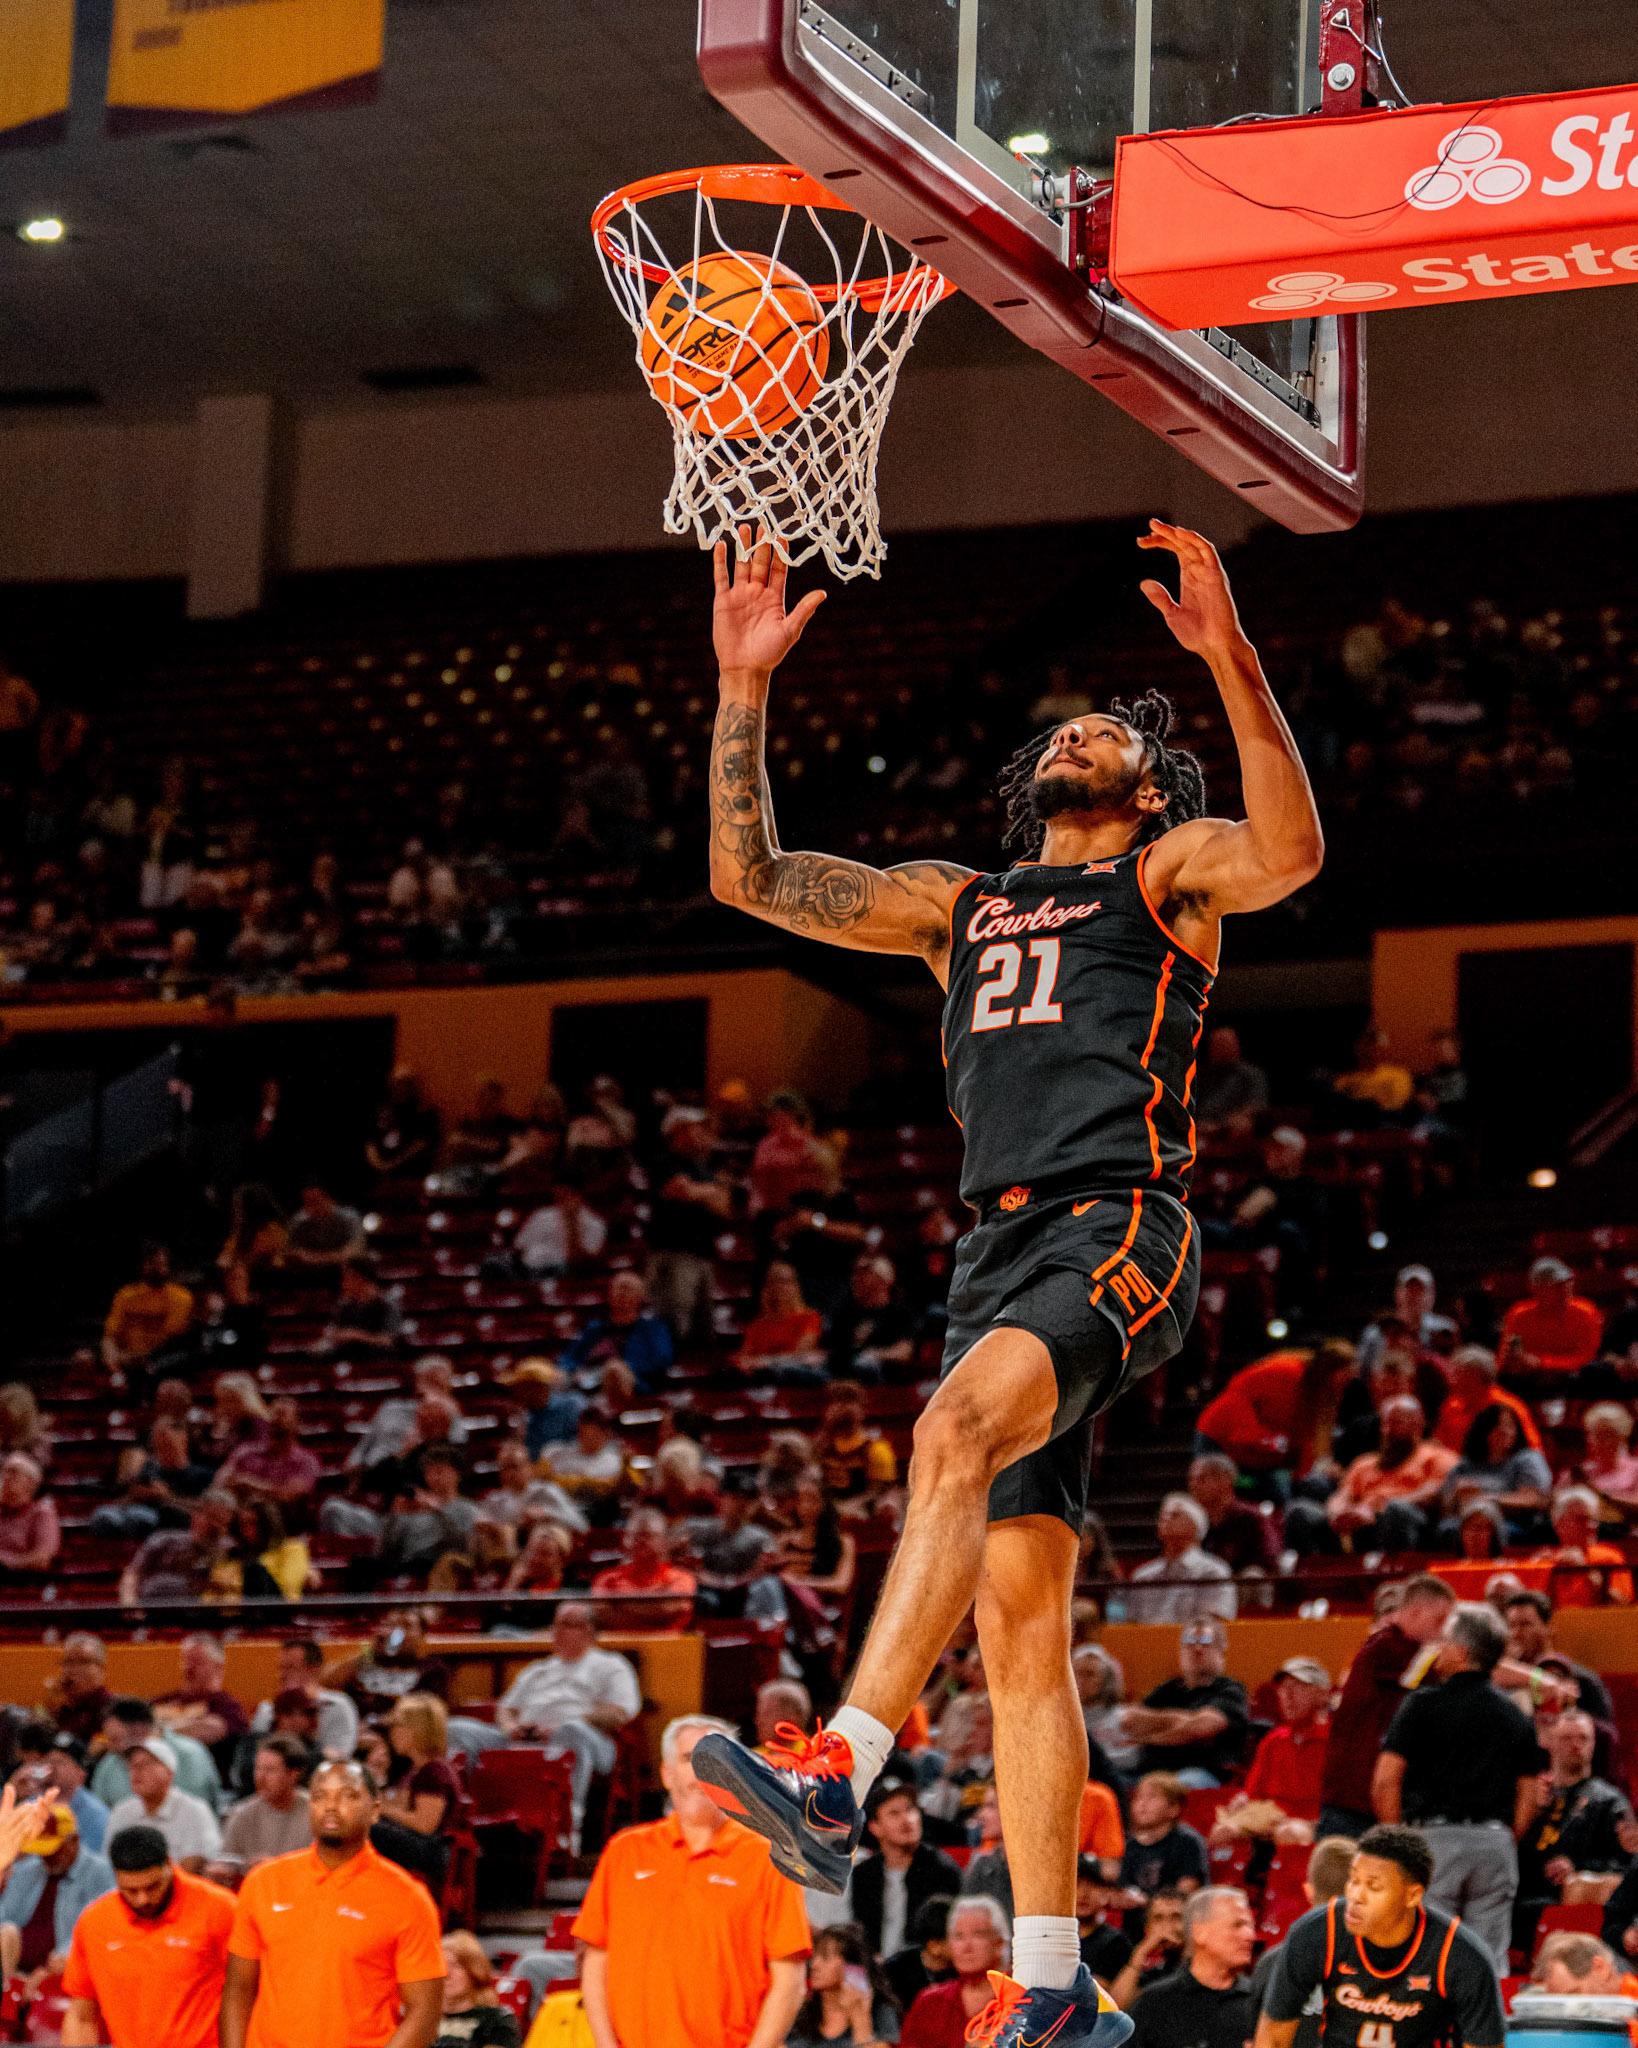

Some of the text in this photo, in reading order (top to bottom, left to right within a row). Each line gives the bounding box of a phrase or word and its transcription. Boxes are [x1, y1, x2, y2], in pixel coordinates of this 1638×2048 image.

[677, 319, 738, 369] PRO
[713, 347, 730, 362] GAME
[966, 896, 1102, 943] Cowboys
[970, 937, 1063, 1034] 21
[1000, 1186, 1031, 1212] OSU
[1335, 1983, 1423, 2021] Cowboys
[1356, 2021, 1397, 2048] 4
